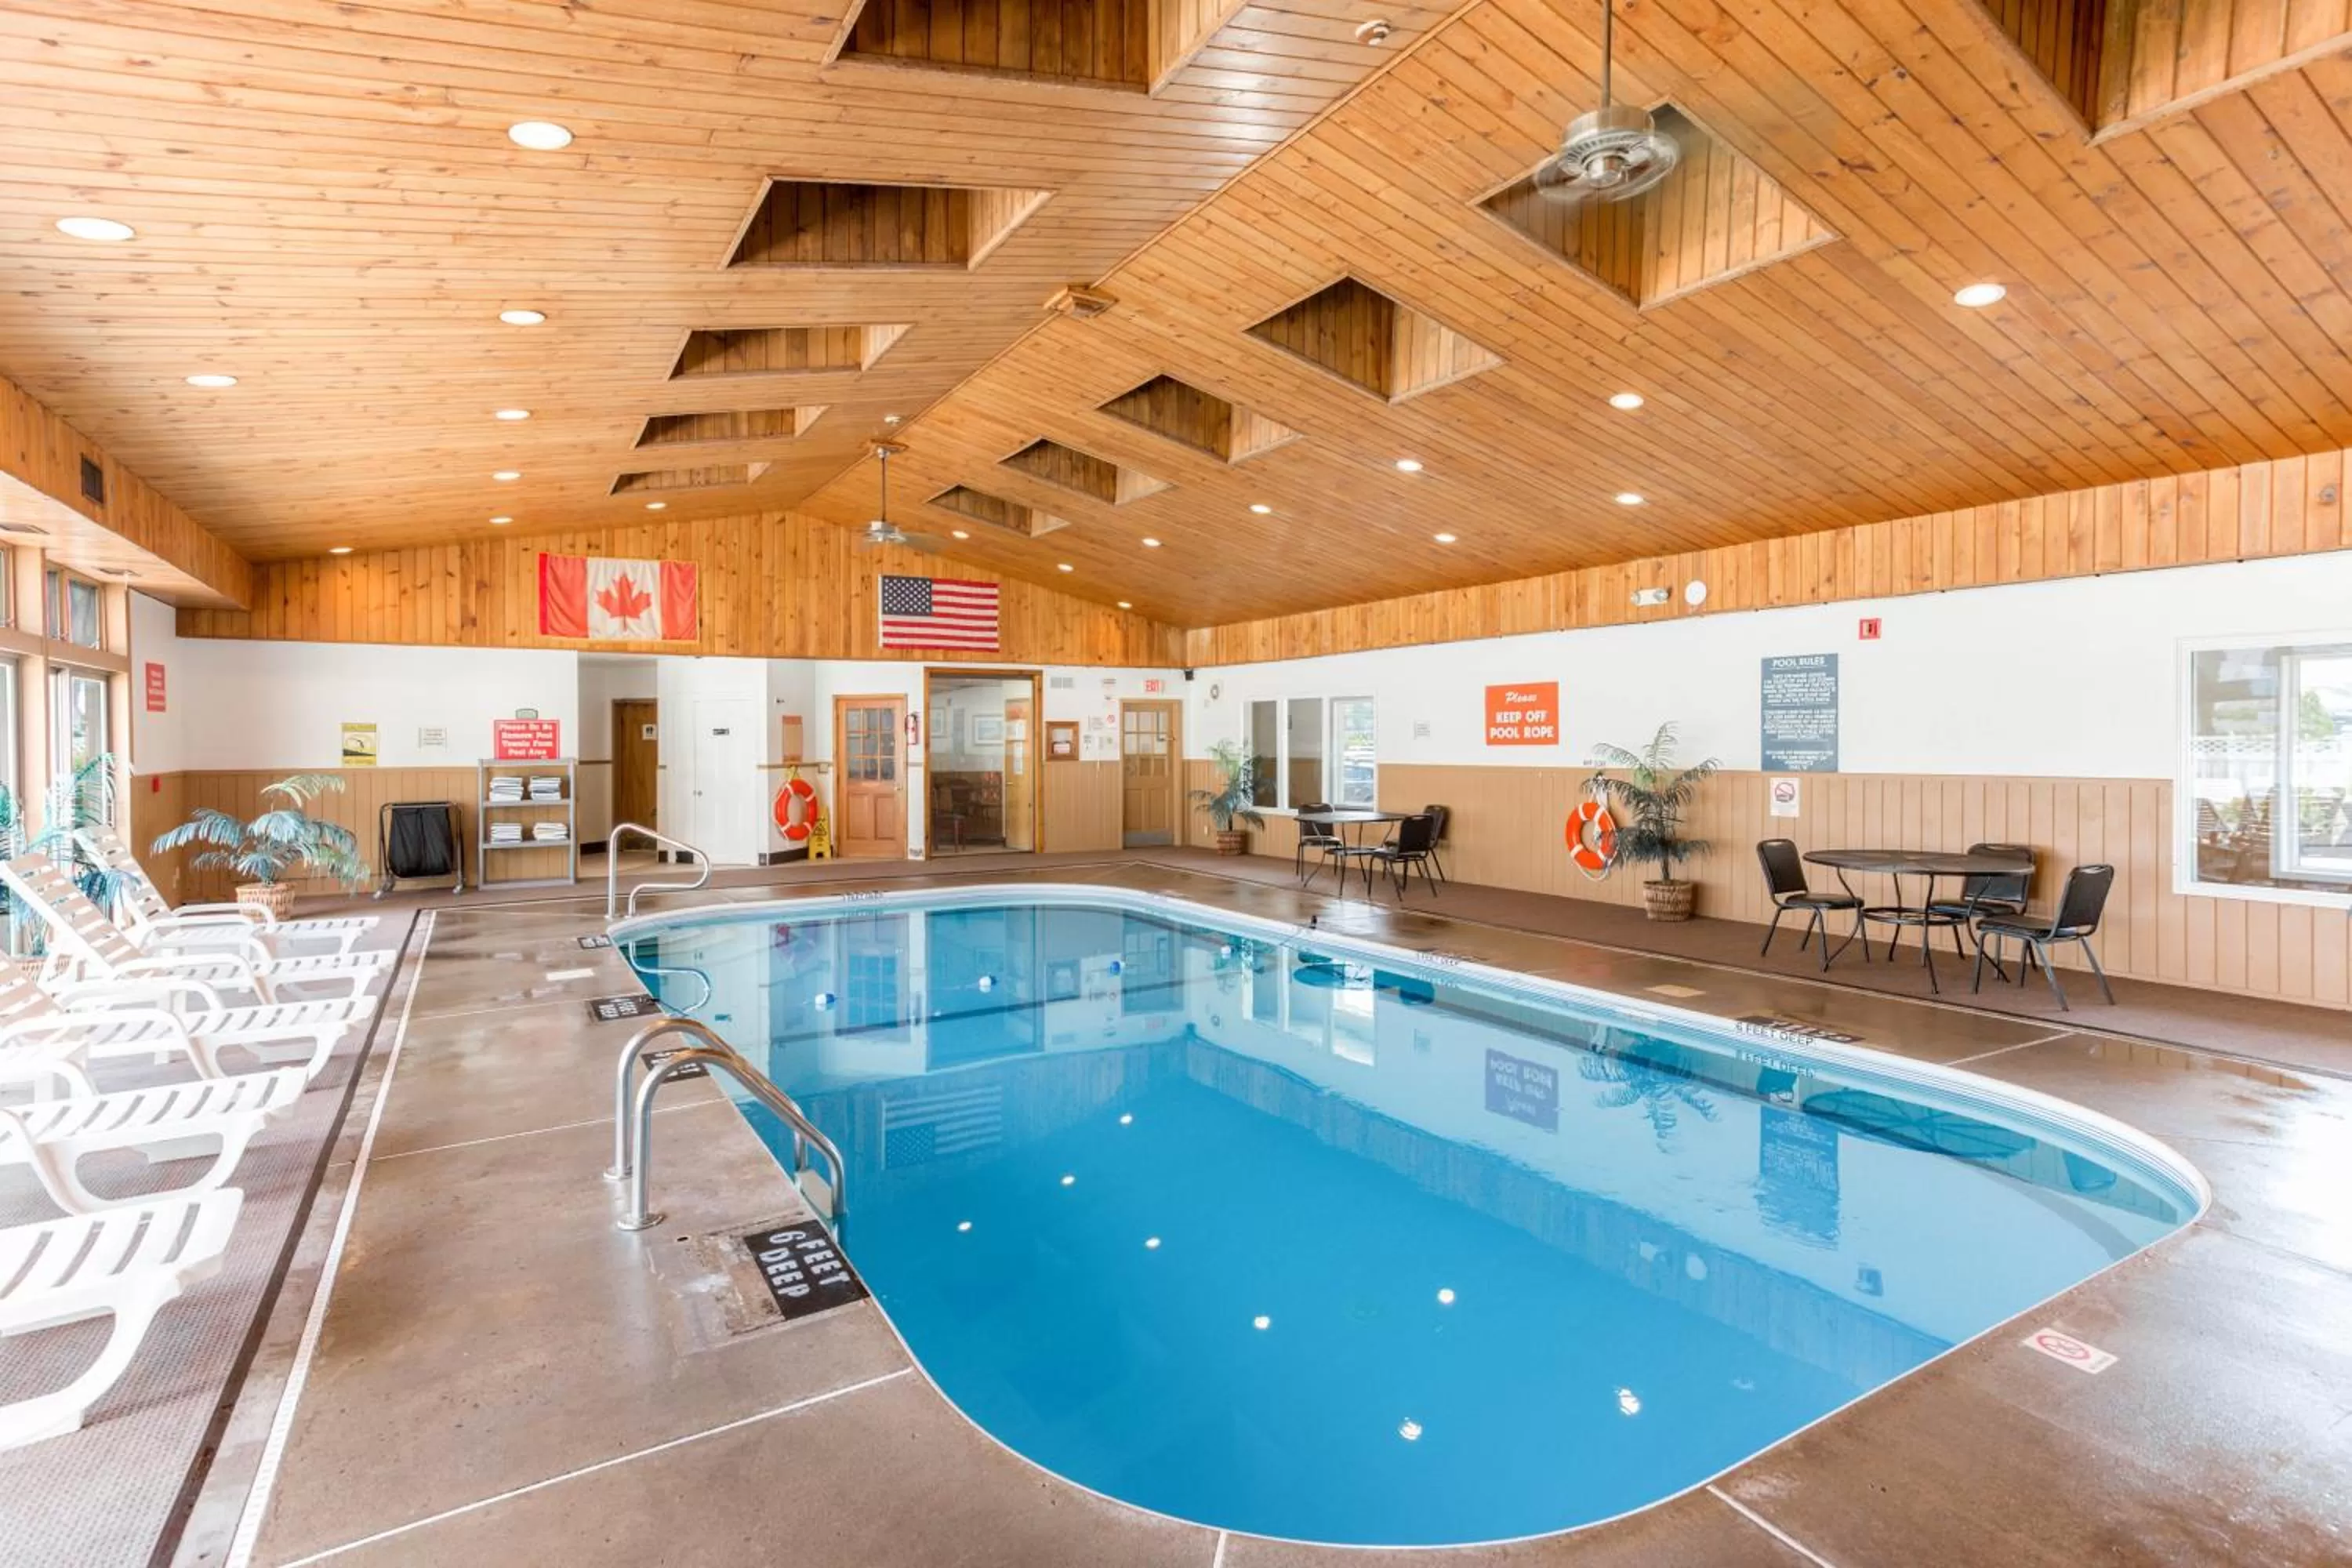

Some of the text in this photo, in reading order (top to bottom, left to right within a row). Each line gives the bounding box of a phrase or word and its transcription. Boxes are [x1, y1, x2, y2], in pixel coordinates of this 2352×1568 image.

[1504, 691, 1537, 704] Please
[1495, 709, 1548, 723] KEEP OFF
[1490, 725, 1554, 739] POOL ROPE
[768, 1230, 851, 1286] 6 FEET
[758, 1247, 811, 1298] DEEP
